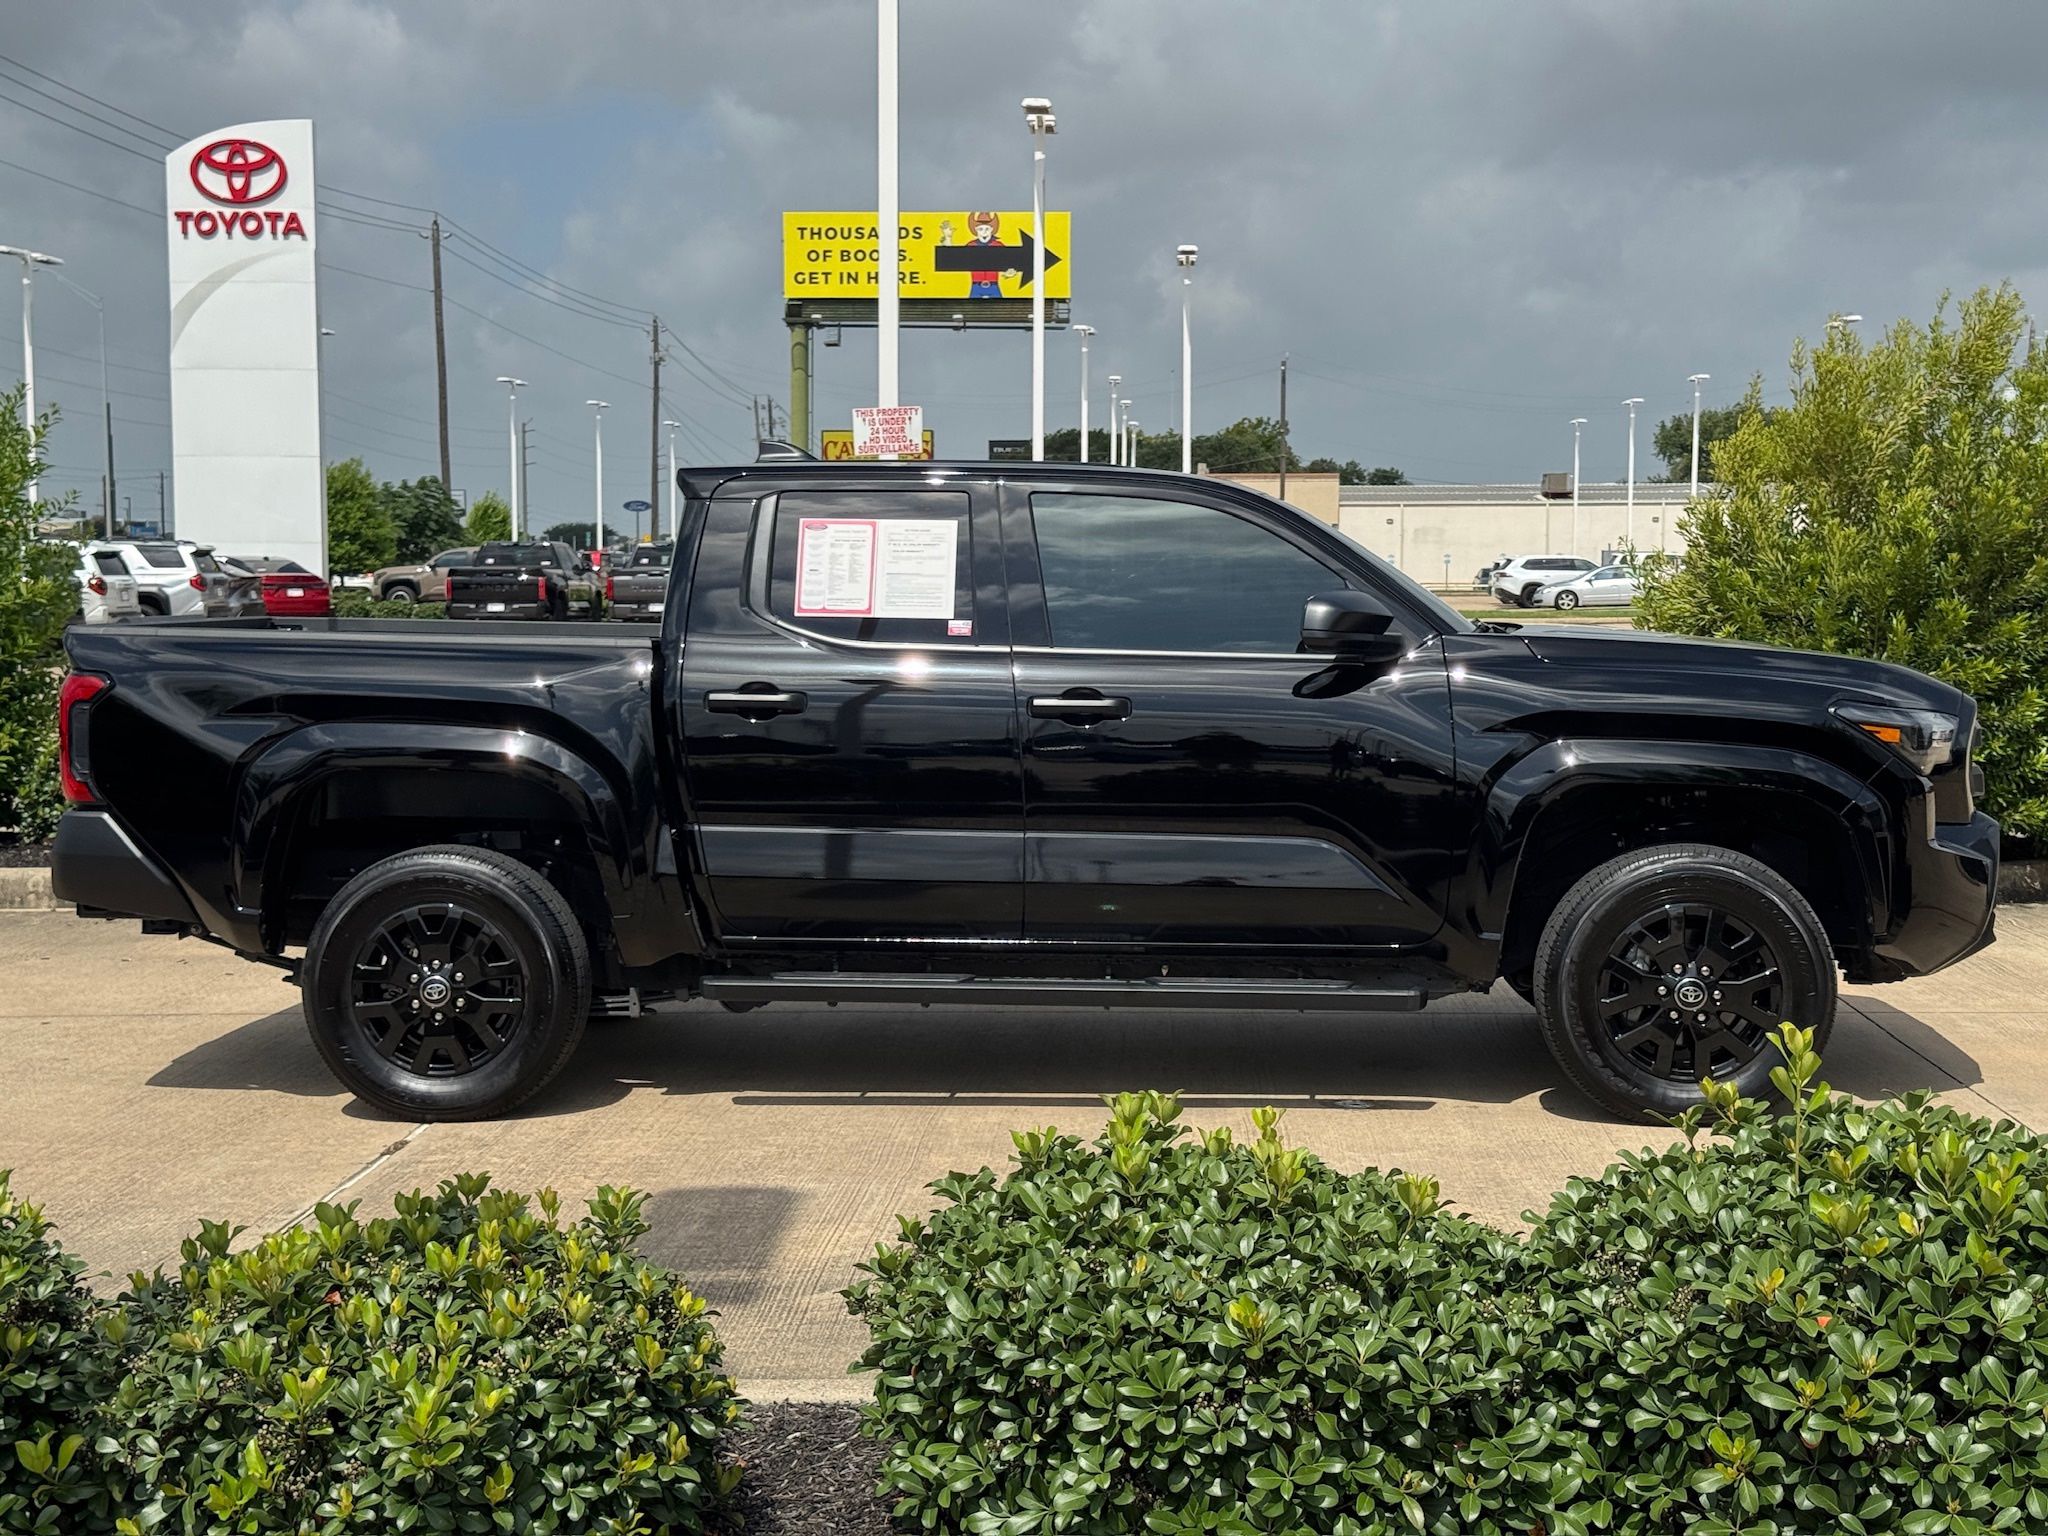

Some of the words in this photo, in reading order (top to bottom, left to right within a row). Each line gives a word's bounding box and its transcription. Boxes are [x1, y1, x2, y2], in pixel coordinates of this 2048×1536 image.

[174, 211, 306, 238] TOYOTA
[797, 226, 923, 240] THOUSADS
[806, 249, 833, 262] OF
[840, 249, 913, 262] BOOS.
[794, 271, 832, 285] GET
[839, 271, 859, 285] IN
[867, 271, 926, 285] HRE.
[855, 410, 874, 418] THIS
[876, 408, 919, 417] PROPERTY
[868, 418, 876, 427] IS
[879, 417, 907, 426] UNDER
[870, 427, 880, 436] 24
[882, 426, 906, 435] HOUR
[869, 436, 880, 445] HD
[883, 435, 908, 444] VIDEO
[858, 444, 920, 454] SURVEILLANCE
